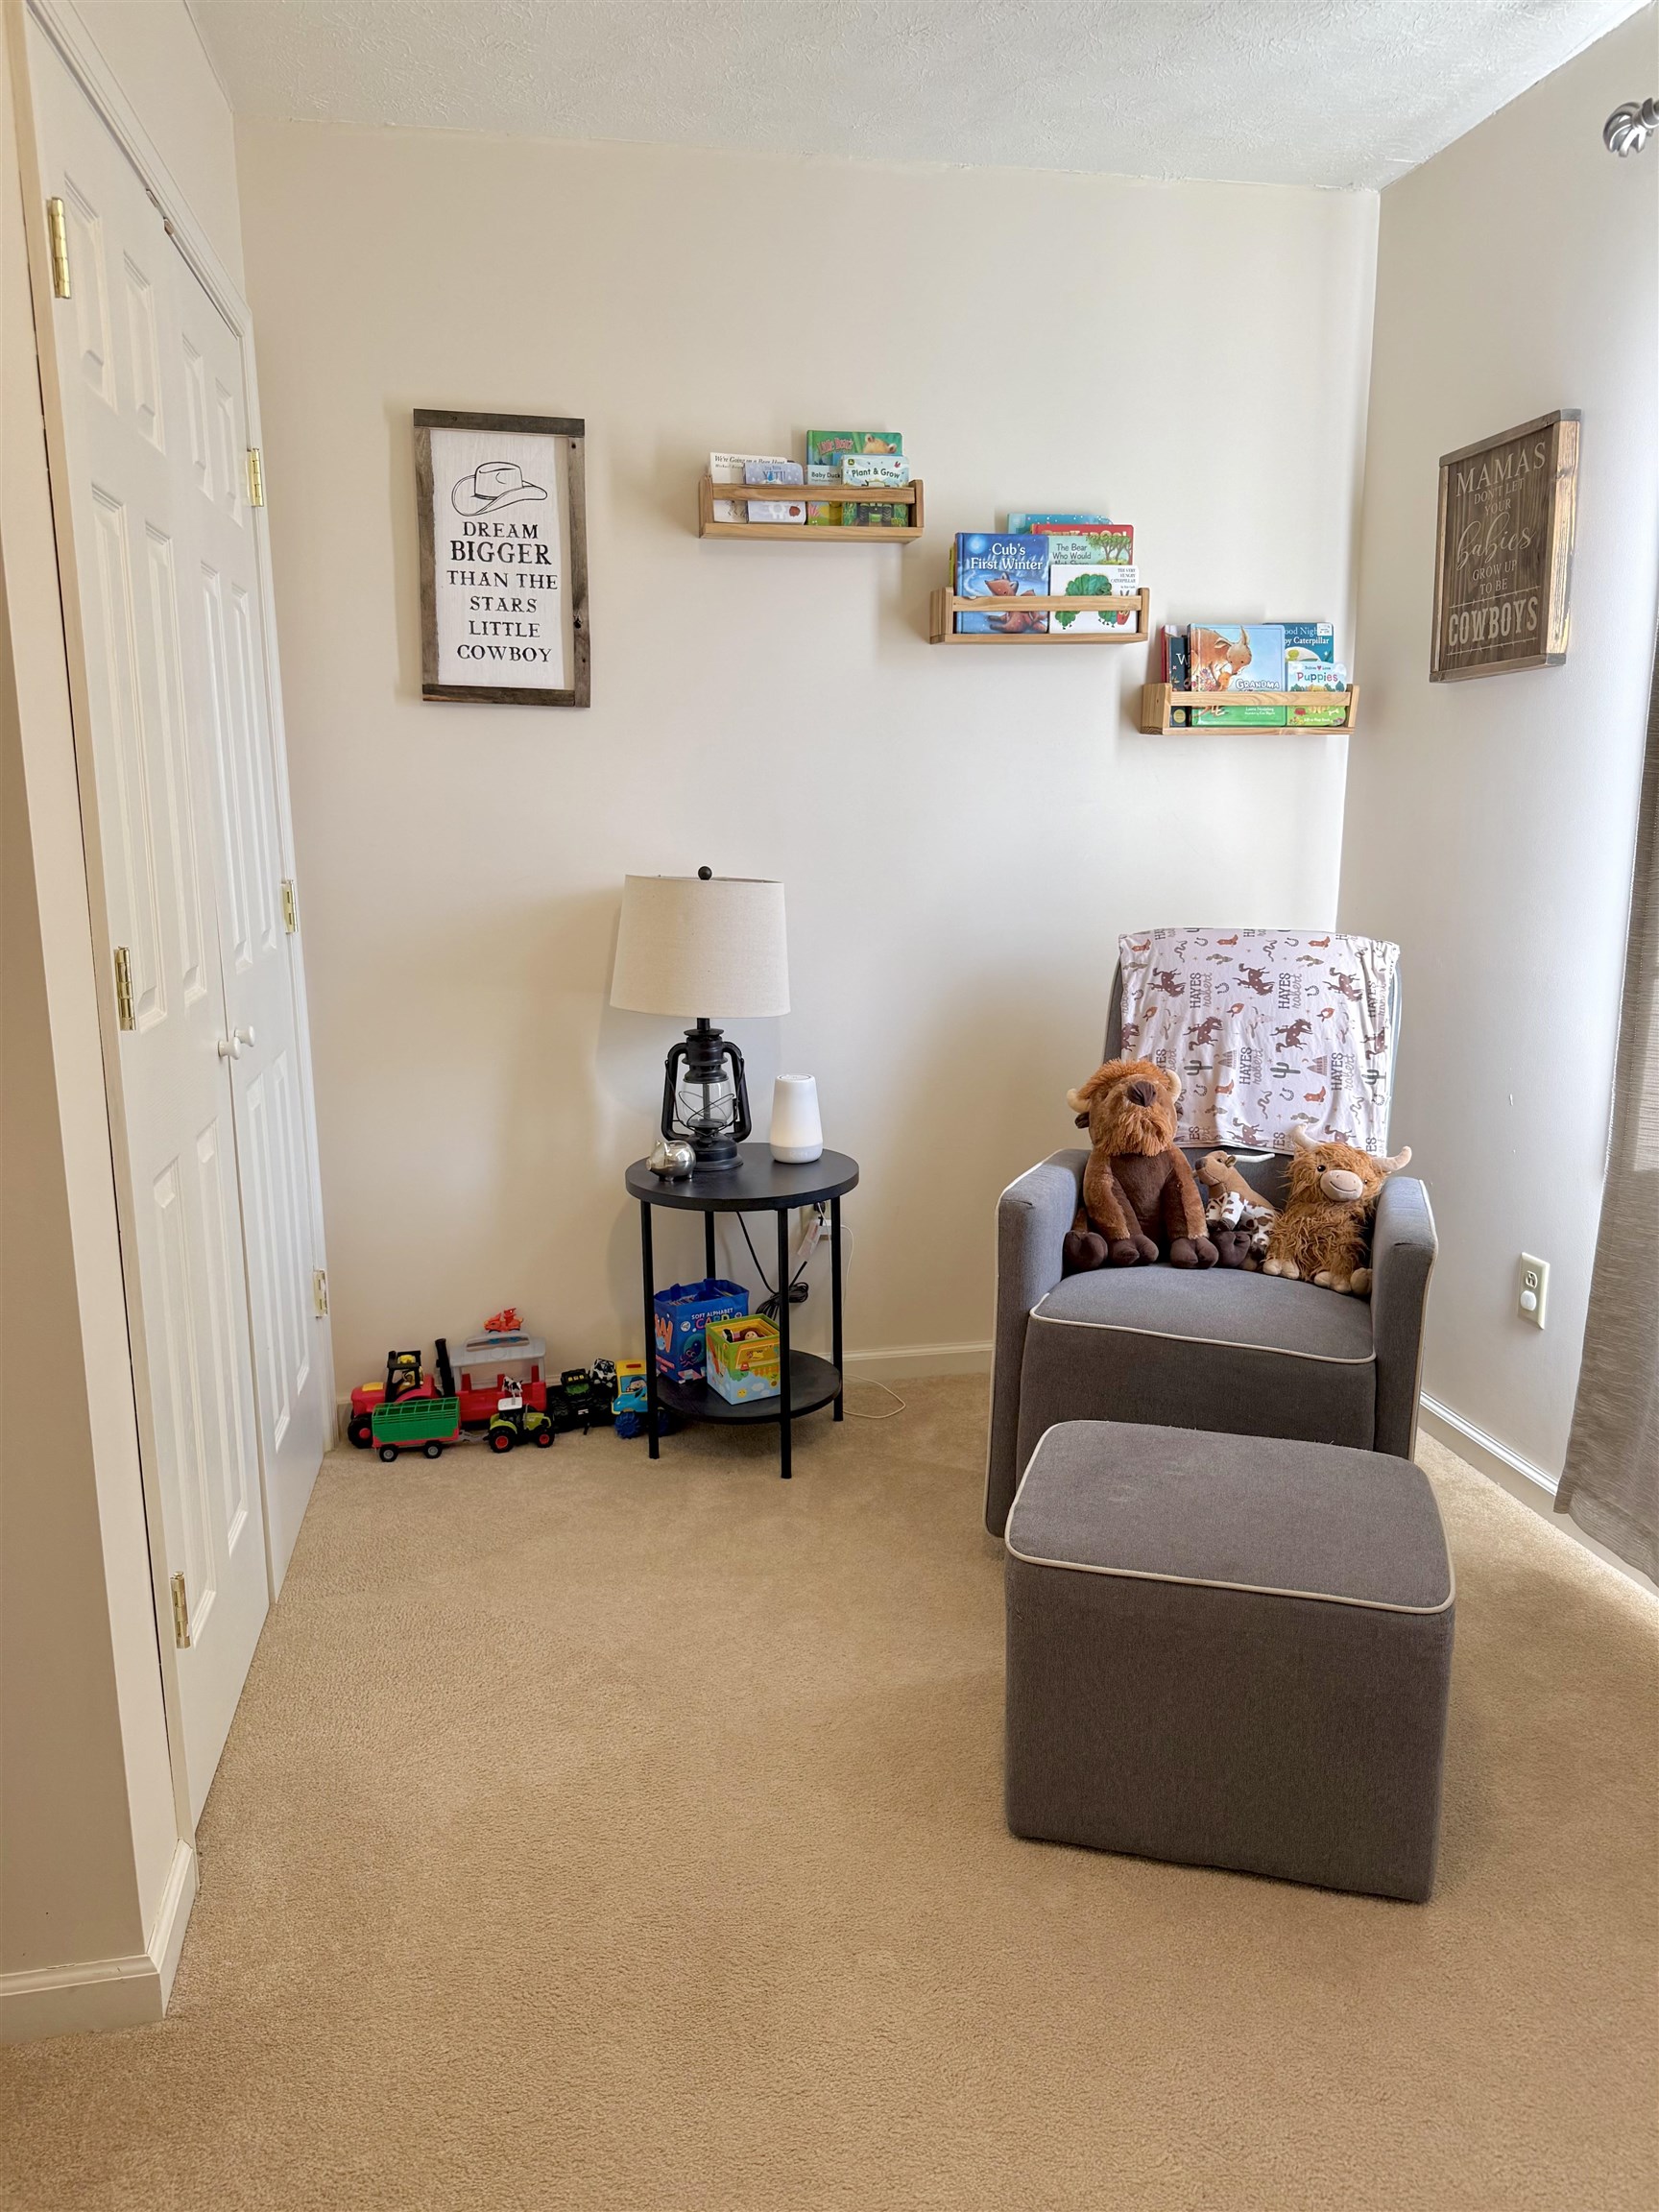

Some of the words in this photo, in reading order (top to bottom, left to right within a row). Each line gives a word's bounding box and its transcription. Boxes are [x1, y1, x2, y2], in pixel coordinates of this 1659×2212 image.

[852, 469, 871, 478] Plant
[880, 468, 901, 479] Grow
[1455, 442, 1546, 497] MAMAS
[1474, 486, 1503, 505] DON'T
[1505, 477, 1525, 494] LET
[1484, 498, 1511, 516] YOUR
[462, 521, 539, 540] DREAM
[992, 542, 1026, 556] Cub's
[1456, 512, 1536, 570] babies
[449, 541, 552, 565] BIGGER
[1070, 551, 1092, 560] Would
[970, 557, 998, 570] First
[1001, 557, 1044, 571] Winter
[1473, 563, 1502, 581] GROW
[1504, 560, 1517, 573] UP
[446, 570, 509, 589] THAN
[517, 573, 558, 590] THE
[1479, 582, 1493, 594] TO
[1495, 578, 1507, 591] BE
[469, 596, 537, 613] STARS
[469, 620, 541, 637] LITTLE
[1448, 596, 1538, 646] COWBOYS
[1285, 626, 1298, 635] ood
[1300, 626, 1317, 637] Nigh
[1293, 636, 1330, 646] Caterpillar
[457, 644, 552, 662] COWBOY
[1236, 679, 1280, 689] GRANDMA
[1297, 672, 1338, 683] Puppies
[1190, 973, 1201, 1008] HAYES
[1202, 973, 1213, 1007] robert
[1278, 973, 1290, 1009] HAYES
[1291, 974, 1302, 1009] robert
[1239, 1046, 1252, 1085] HAYES
[1252, 1048, 1263, 1085] robert
[1331, 1052, 1343, 1091] HAYES
[707, 1308, 733, 1316] ALPHABET
